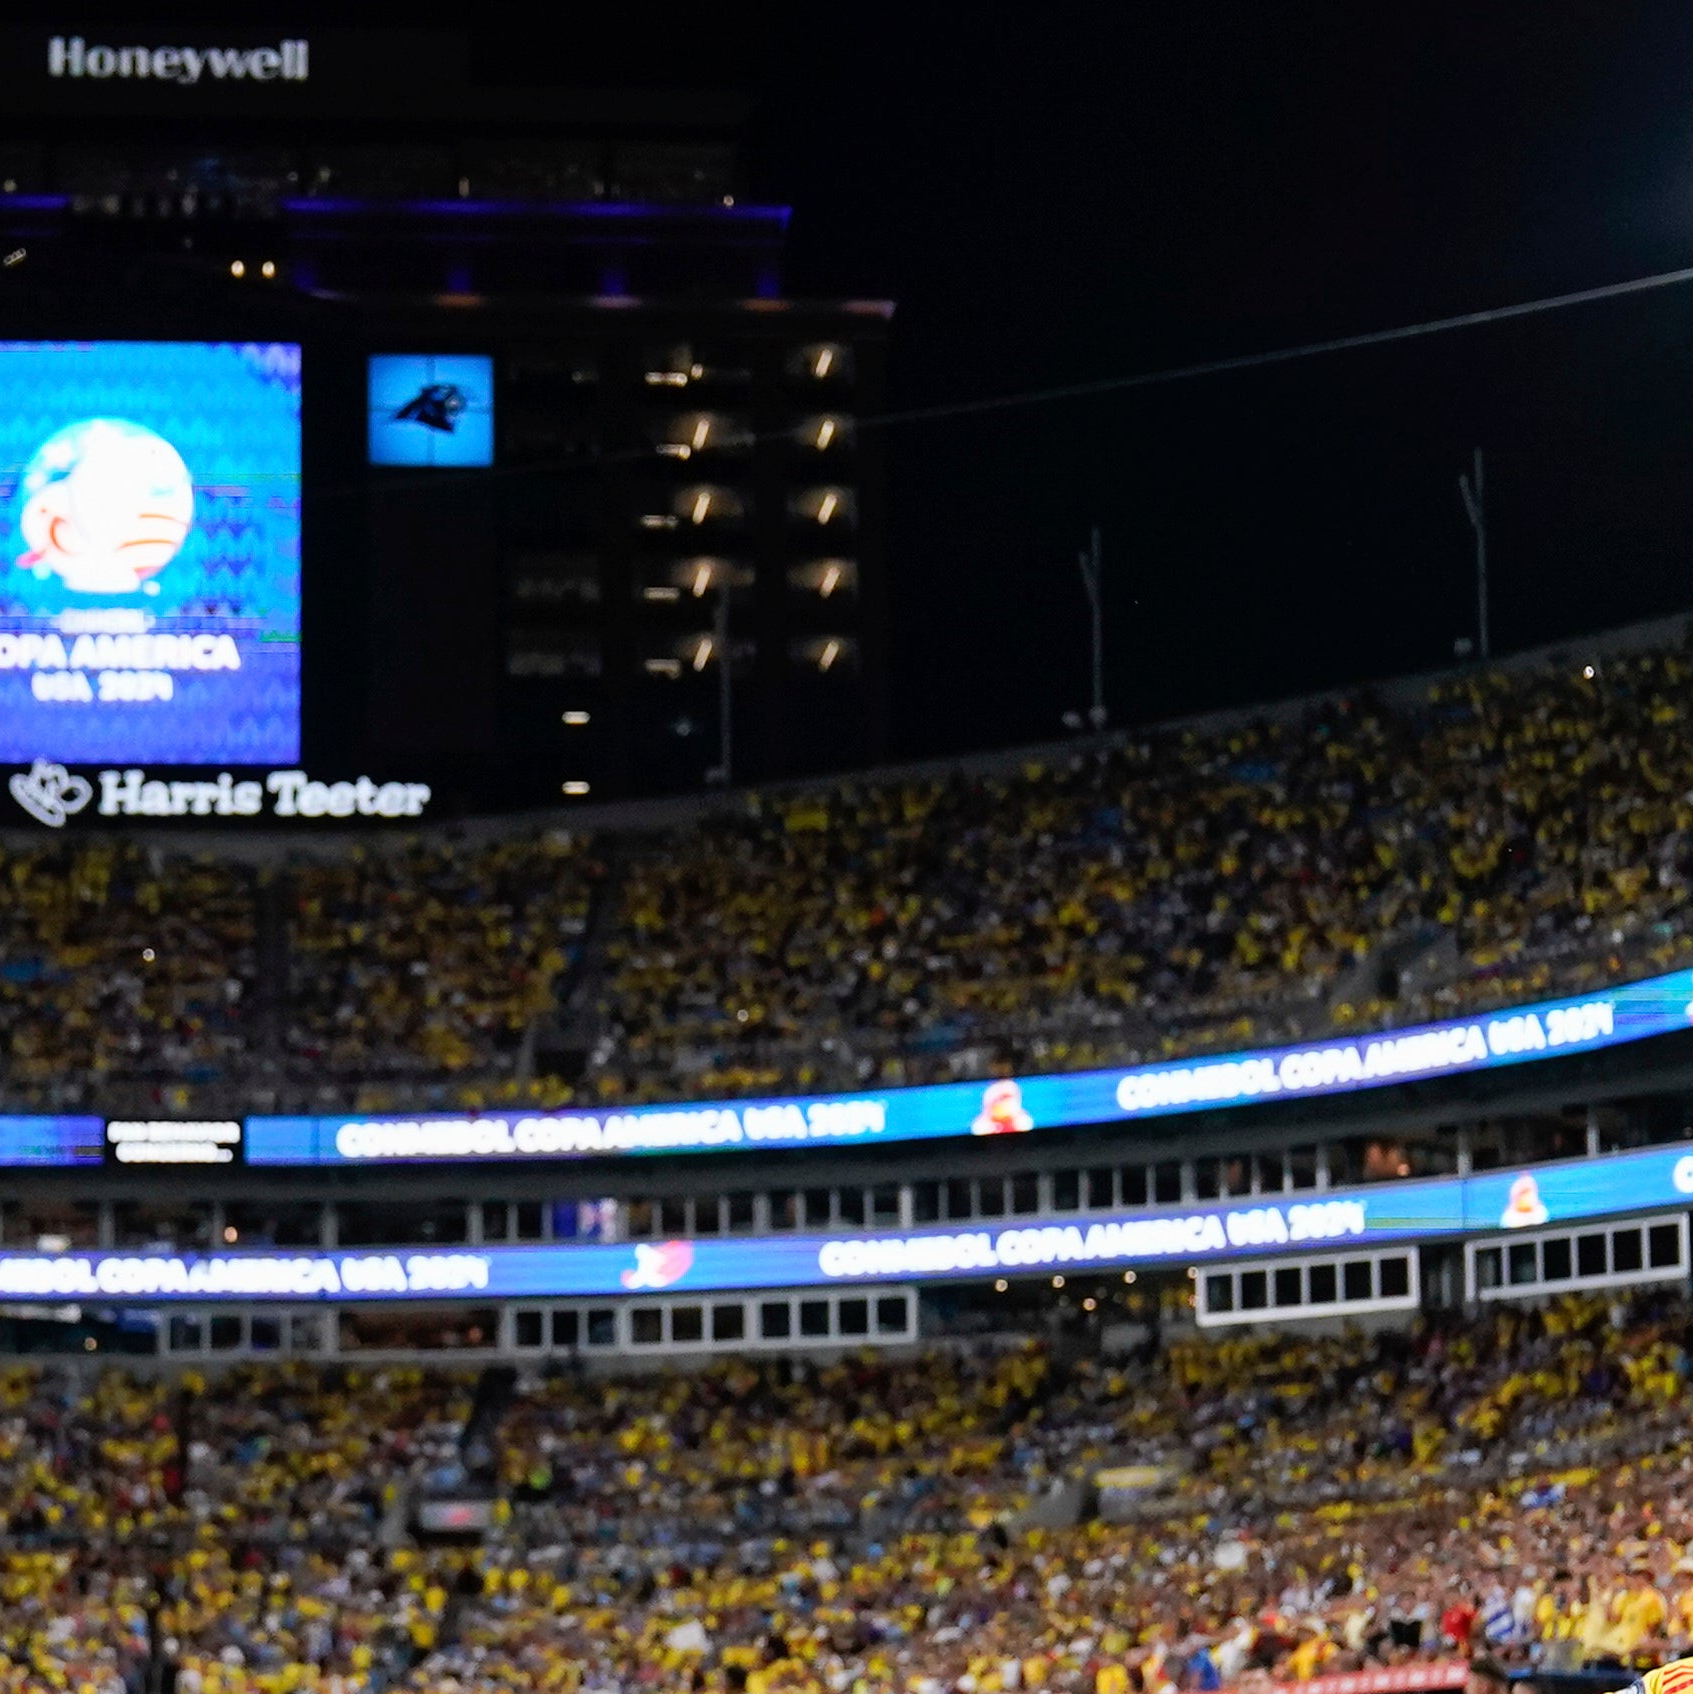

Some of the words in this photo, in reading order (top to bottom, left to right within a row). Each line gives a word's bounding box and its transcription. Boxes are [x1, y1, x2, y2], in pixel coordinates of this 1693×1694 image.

[48, 36, 309, 84] Honeywell
[99, 769, 262, 816] Harris
[268, 769, 430, 817] Teeter
